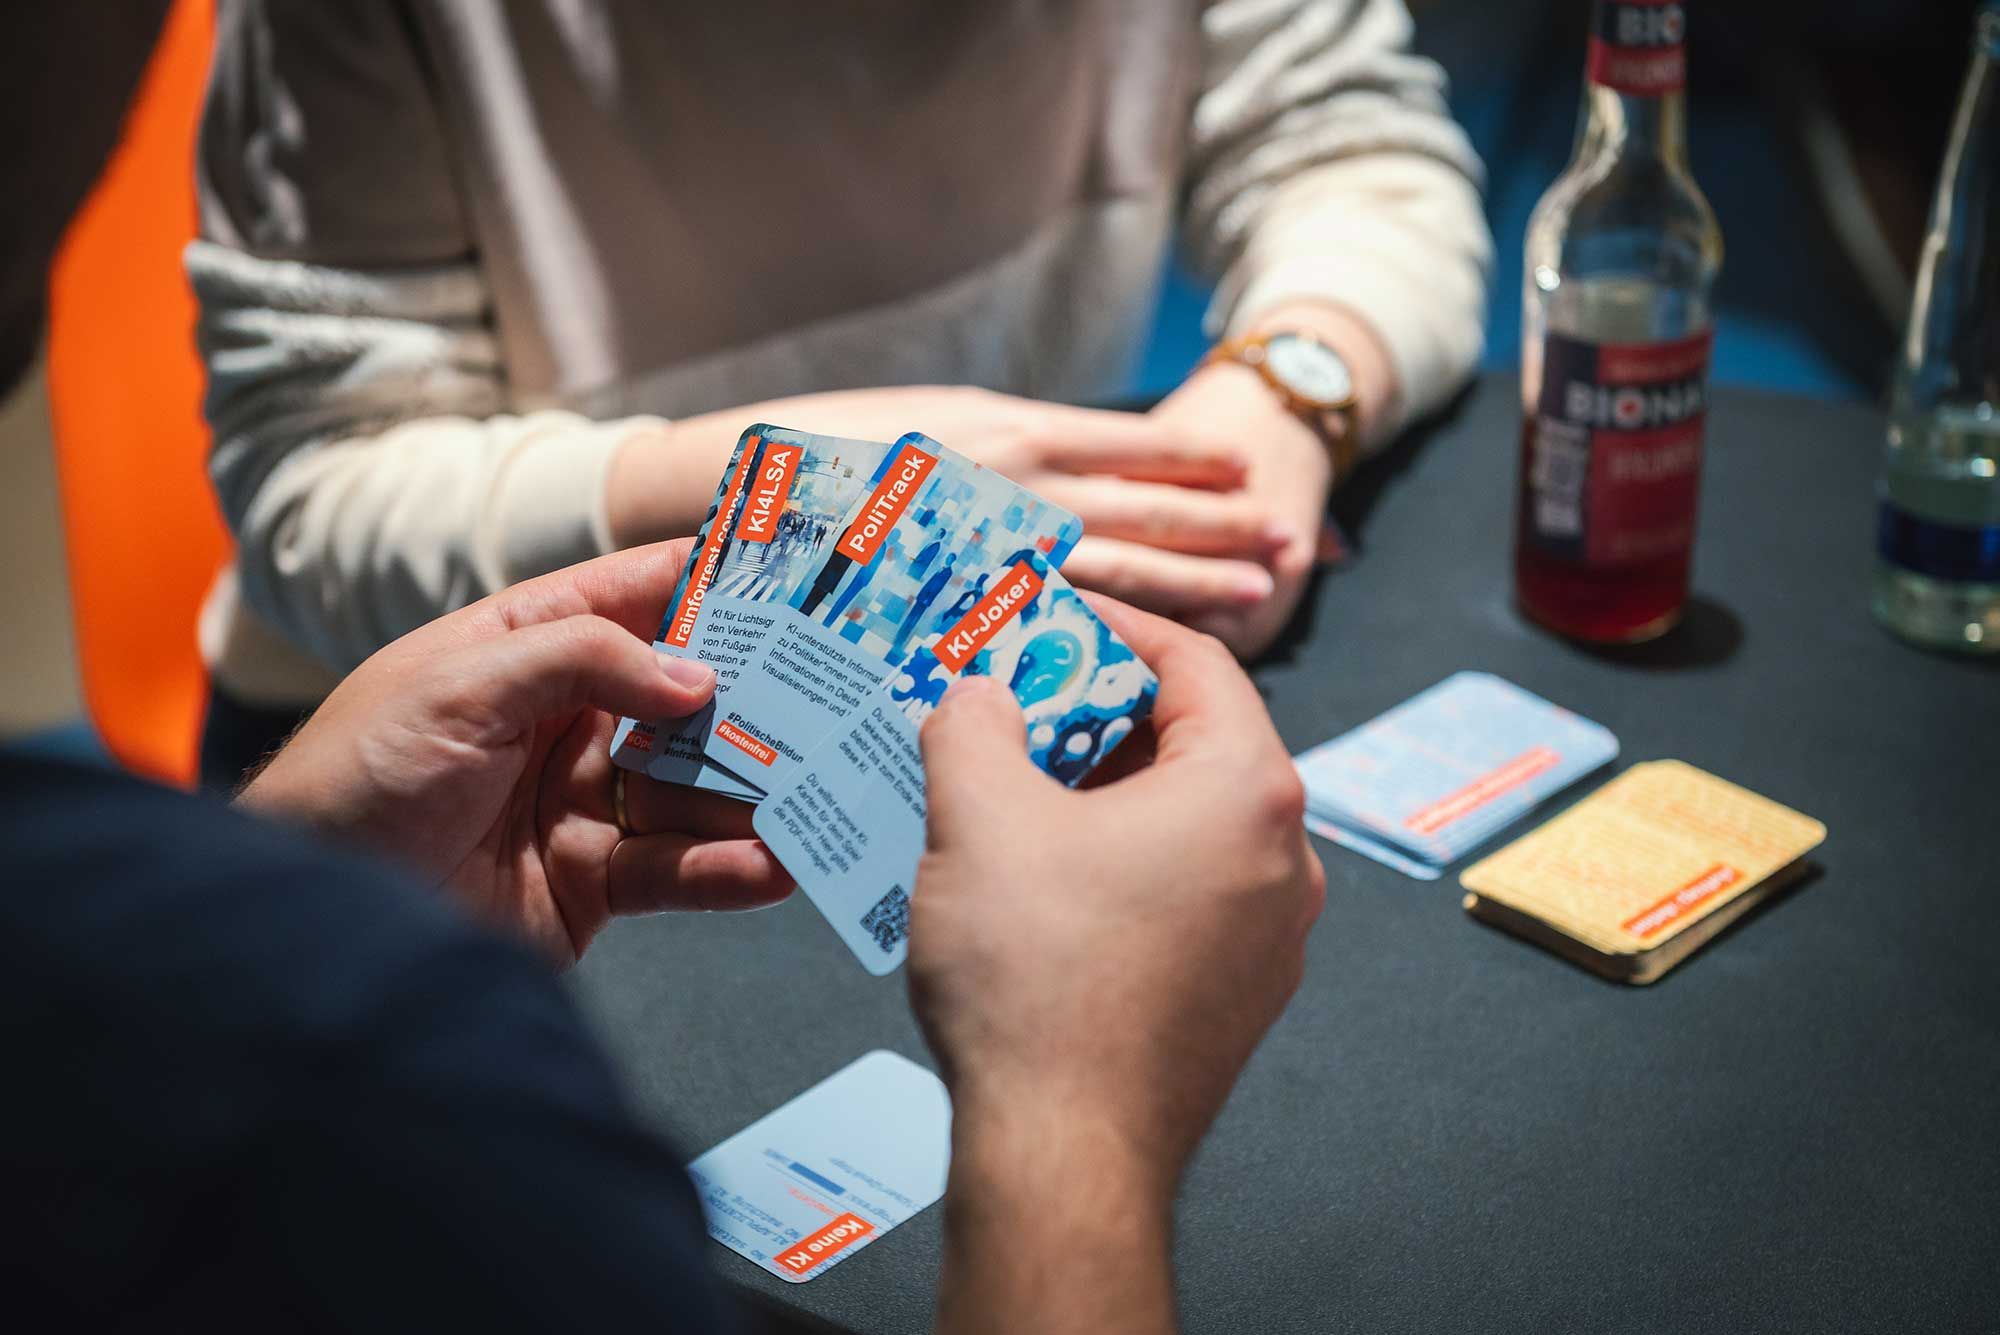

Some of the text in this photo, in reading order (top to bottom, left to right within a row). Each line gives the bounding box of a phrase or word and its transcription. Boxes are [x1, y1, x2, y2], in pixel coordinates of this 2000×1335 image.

[748, 450, 792, 534] KI4LSA
[849, 454, 926, 553] PoliTrack
[675, 545, 721, 642] rainforrest
[707, 623, 724, 633] den
[712, 608, 722, 618] KI
[724, 610, 736, 620] für
[946, 574, 1032, 659] KI-Joker
[698, 650, 738, 664] Situation
[703, 638, 719, 647] von
[786, 623, 846, 664] KI-unterstützte
[769, 648, 825, 687] Informationen
[825, 682, 834, 693] in
[777, 637, 789, 648] zu
[848, 680, 866, 693] und
[762, 660, 847, 717] Visualisierungen und
[718, 724, 770, 761] #kostenfrei
[728, 711, 805, 764] #PolitischeBildun
[861, 718, 892, 756] bekannte
[872, 707, 884, 722] Du
[883, 722, 904, 745] darfst
[795, 784, 819, 812] Karten
[806, 773, 819, 788] Du
[879, 765, 895, 782] zum
[893, 780, 912, 803] Ende
[774, 808, 786, 820] die
[808, 1219, 864, 1254] Keine
[785, 1251, 814, 1269] KI
